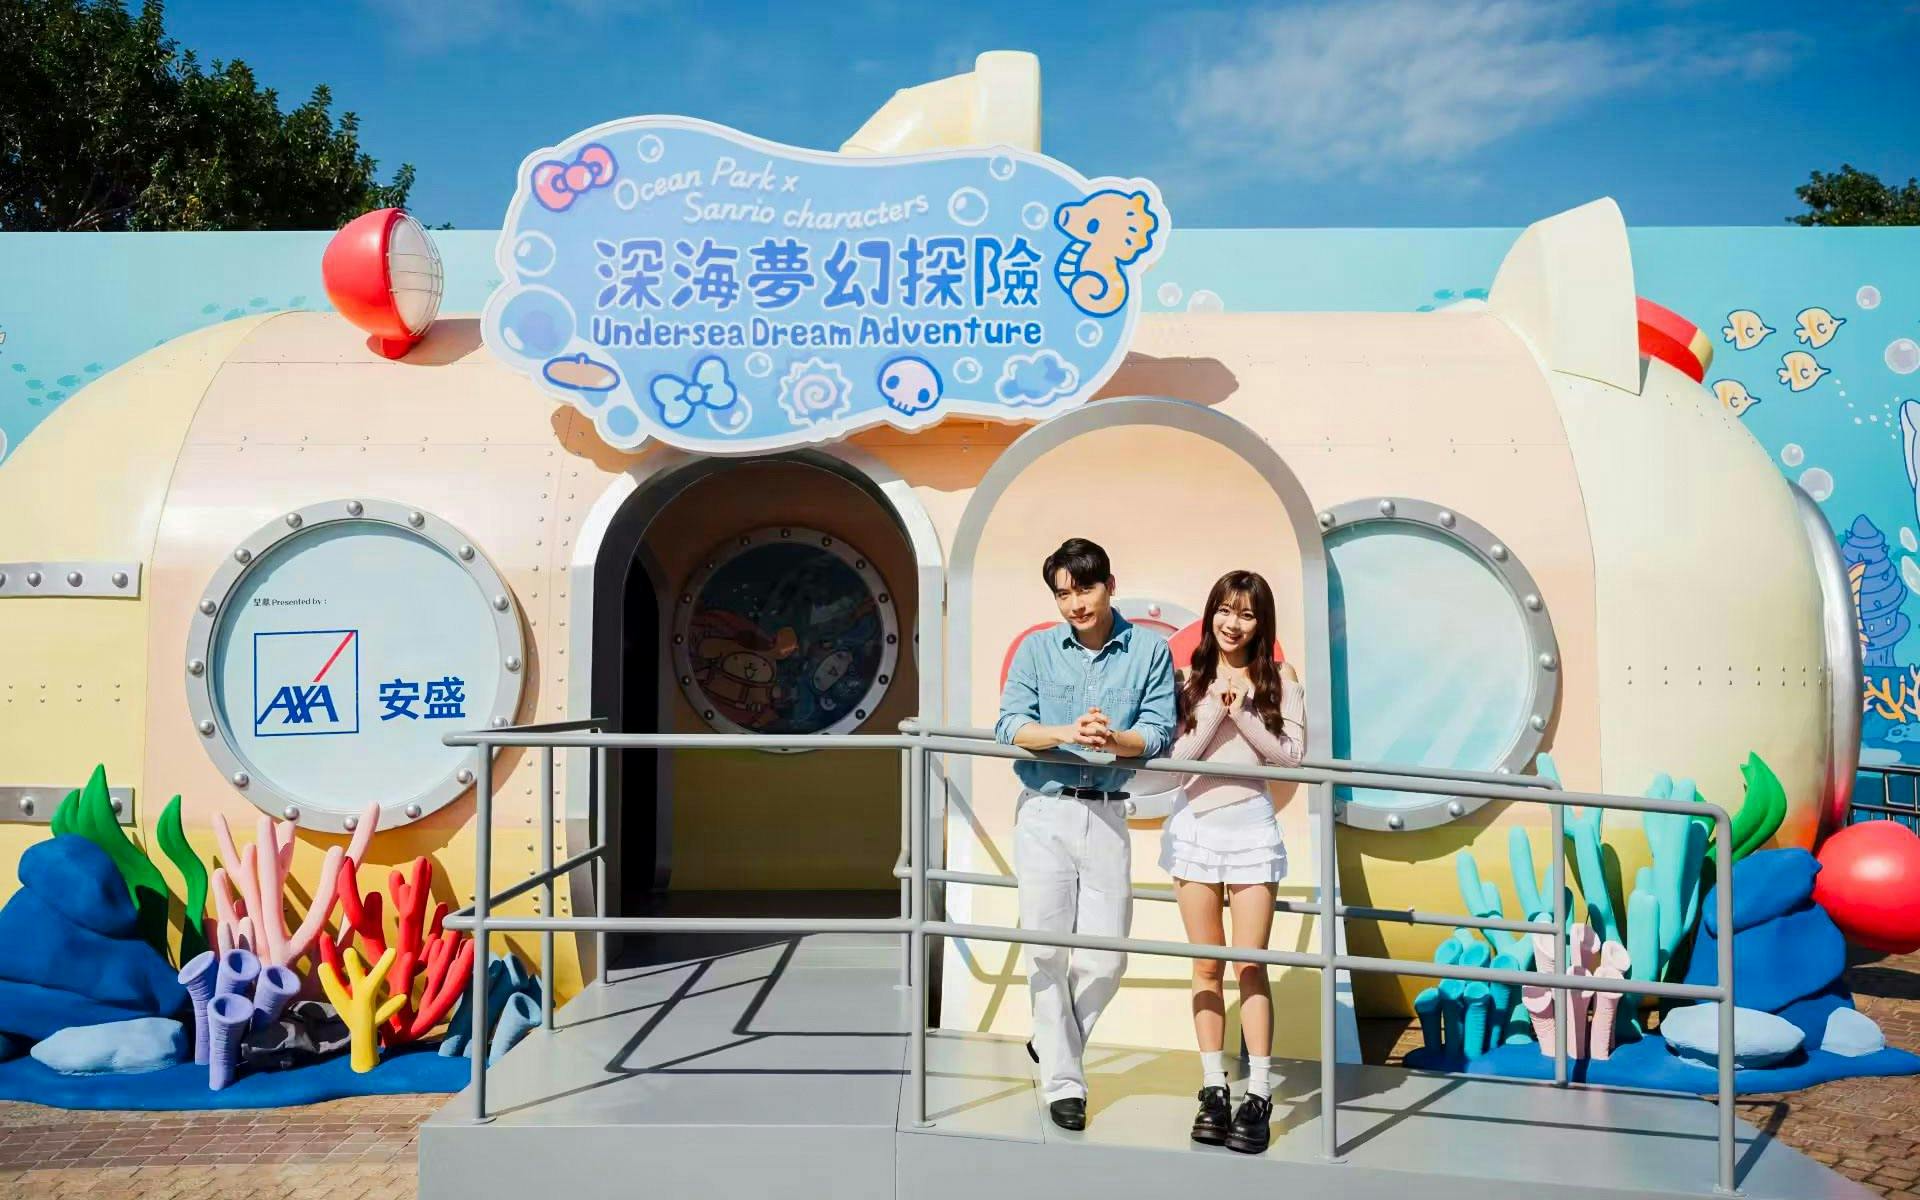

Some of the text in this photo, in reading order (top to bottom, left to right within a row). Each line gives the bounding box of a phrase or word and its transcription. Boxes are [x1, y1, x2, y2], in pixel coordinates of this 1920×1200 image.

[614, 168, 702, 210] Ocean
[711, 156, 776, 191] Park
[683, 192, 929, 229] Sanrio characters
[595, 236, 1042, 307] 深海夢幻探險
[592, 315, 1042, 347] Undersea Dream Adventure
[271, 597, 311, 606] Presented
[256, 684, 339, 724] AXA
[378, 676, 466, 721] 安盛
